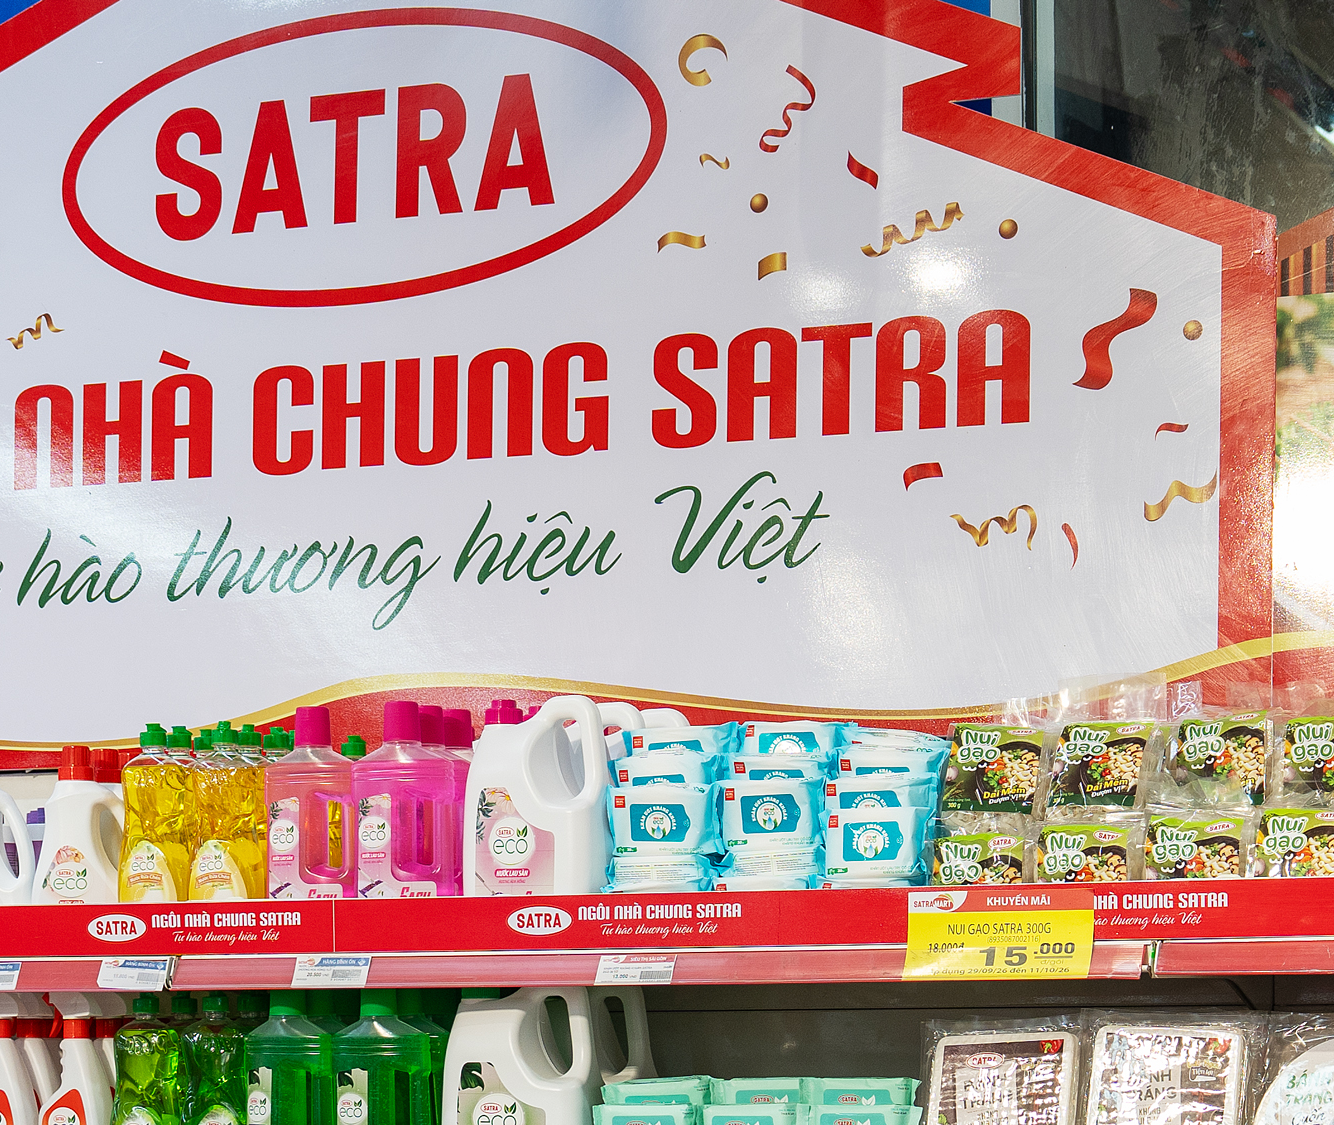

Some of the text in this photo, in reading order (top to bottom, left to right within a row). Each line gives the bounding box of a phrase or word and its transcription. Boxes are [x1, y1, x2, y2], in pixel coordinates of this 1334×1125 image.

[155, 73, 557, 243] SATRA
[14, 351, 213, 490] NHÀ
[251, 341, 610, 476] CHUNG
[651, 309, 1031, 446] SATRA
[16, 518, 142, 609] hào
[167, 517, 439, 630] thương
[454, 500, 621, 597] hiệu
[654, 471, 829, 593] Việt
[965, 729, 1001, 746] Nui
[958, 746, 1000, 762] gạo
[493, 839, 528, 854] eco
[987, 894, 1051, 906] KHUYẾN MÃI
[152, 910, 301, 928] NGÔI NHÀ CHUNG SATRA
[96, 921, 137, 935] SATRA
[947, 923, 1051, 937] NUI GẠO SATRA 300G
[172, 928, 280, 946] Tự hào thương hiệu Việt
[979, 943, 1075, 966] 15 .000
